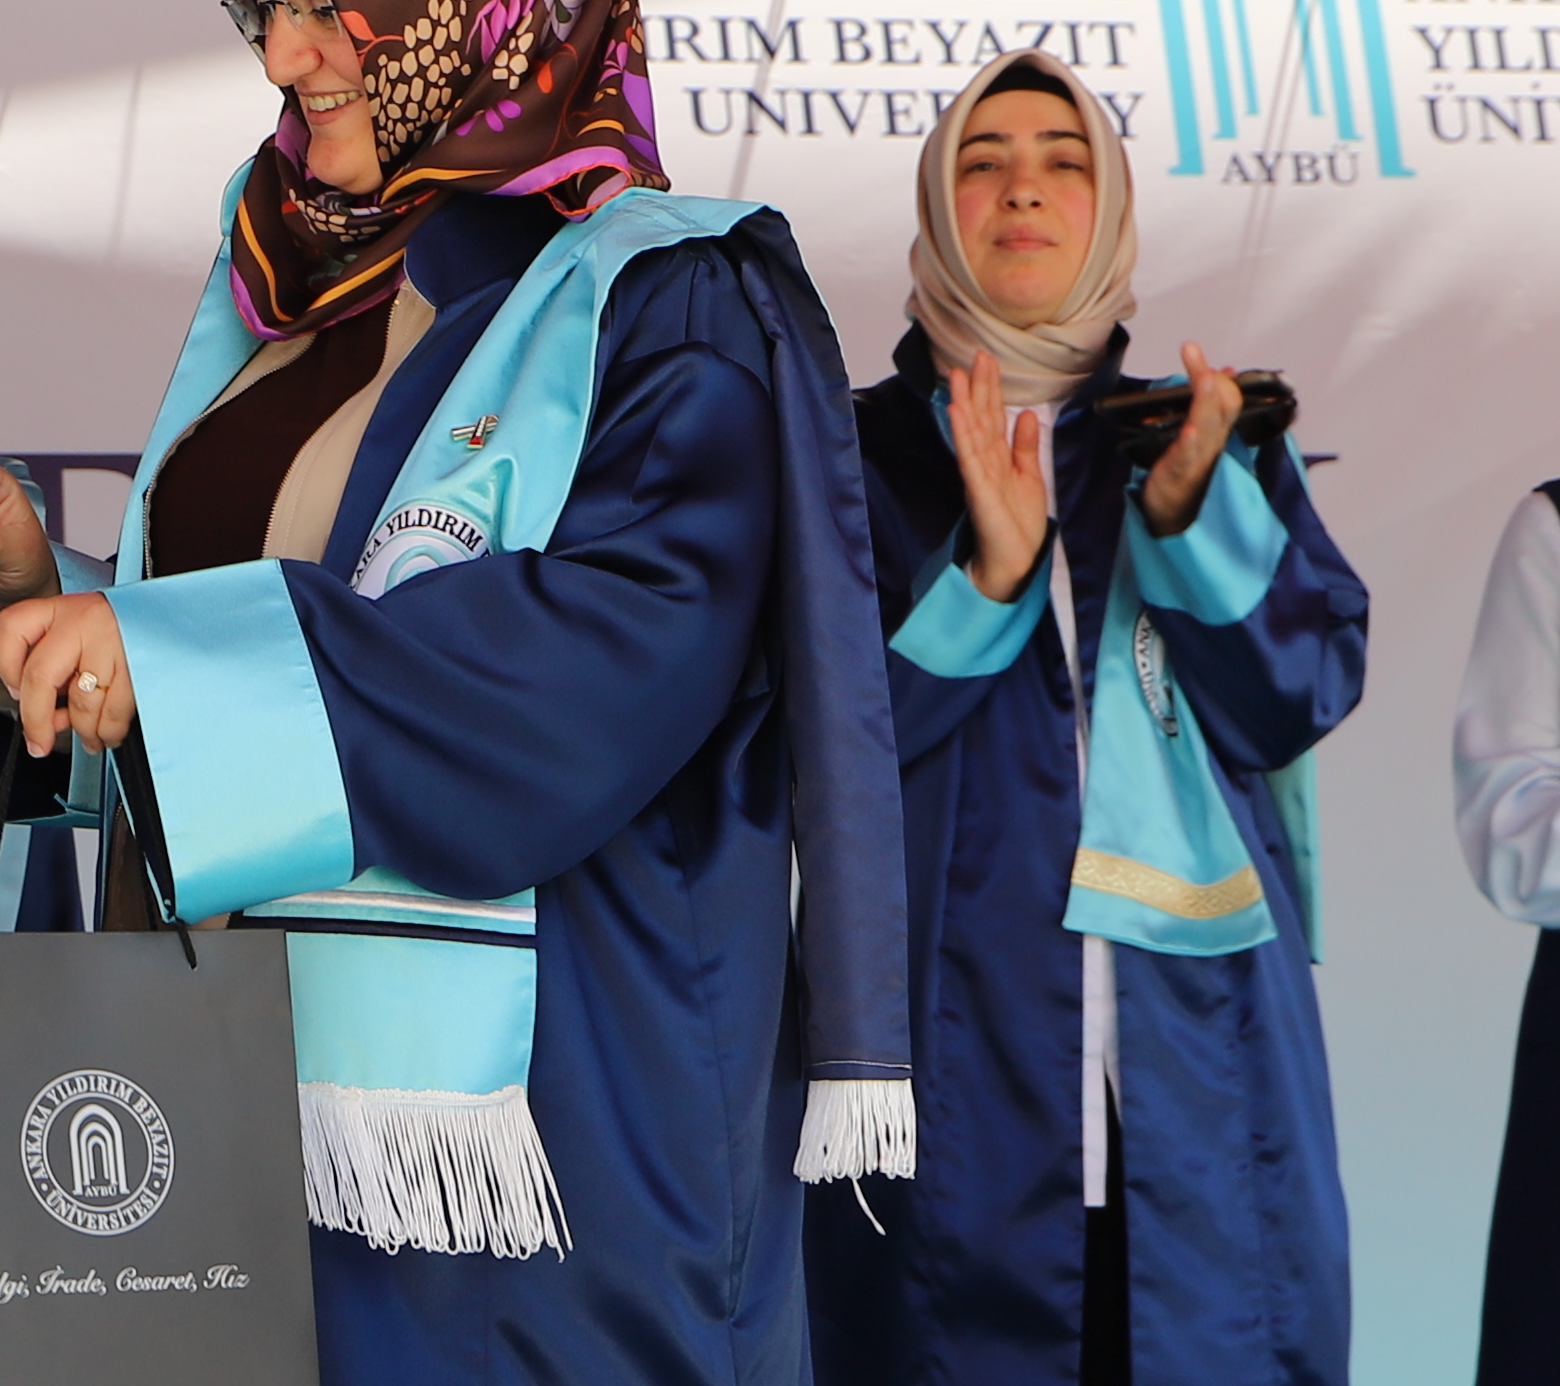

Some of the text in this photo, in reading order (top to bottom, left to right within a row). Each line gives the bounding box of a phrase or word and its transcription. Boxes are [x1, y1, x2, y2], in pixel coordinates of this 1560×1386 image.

[831, 16, 1137, 67] BEYAZIT
[682, 85, 1145, 139] UNIVEY
[1220, 143, 1361, 187] AYBÜ
[385, 508, 483, 553] YILDIRIM
[26, 1074, 170, 1181] ANKARA YILDIRIM BEYAZIT
[45, 1187, 159, 1232] ÜNİVERSİTESİ
[84, 1184, 118, 1198] AYBÜ
[35, 1264, 108, 1296] İrade,
[115, 1265, 198, 1294] Cesaret,
